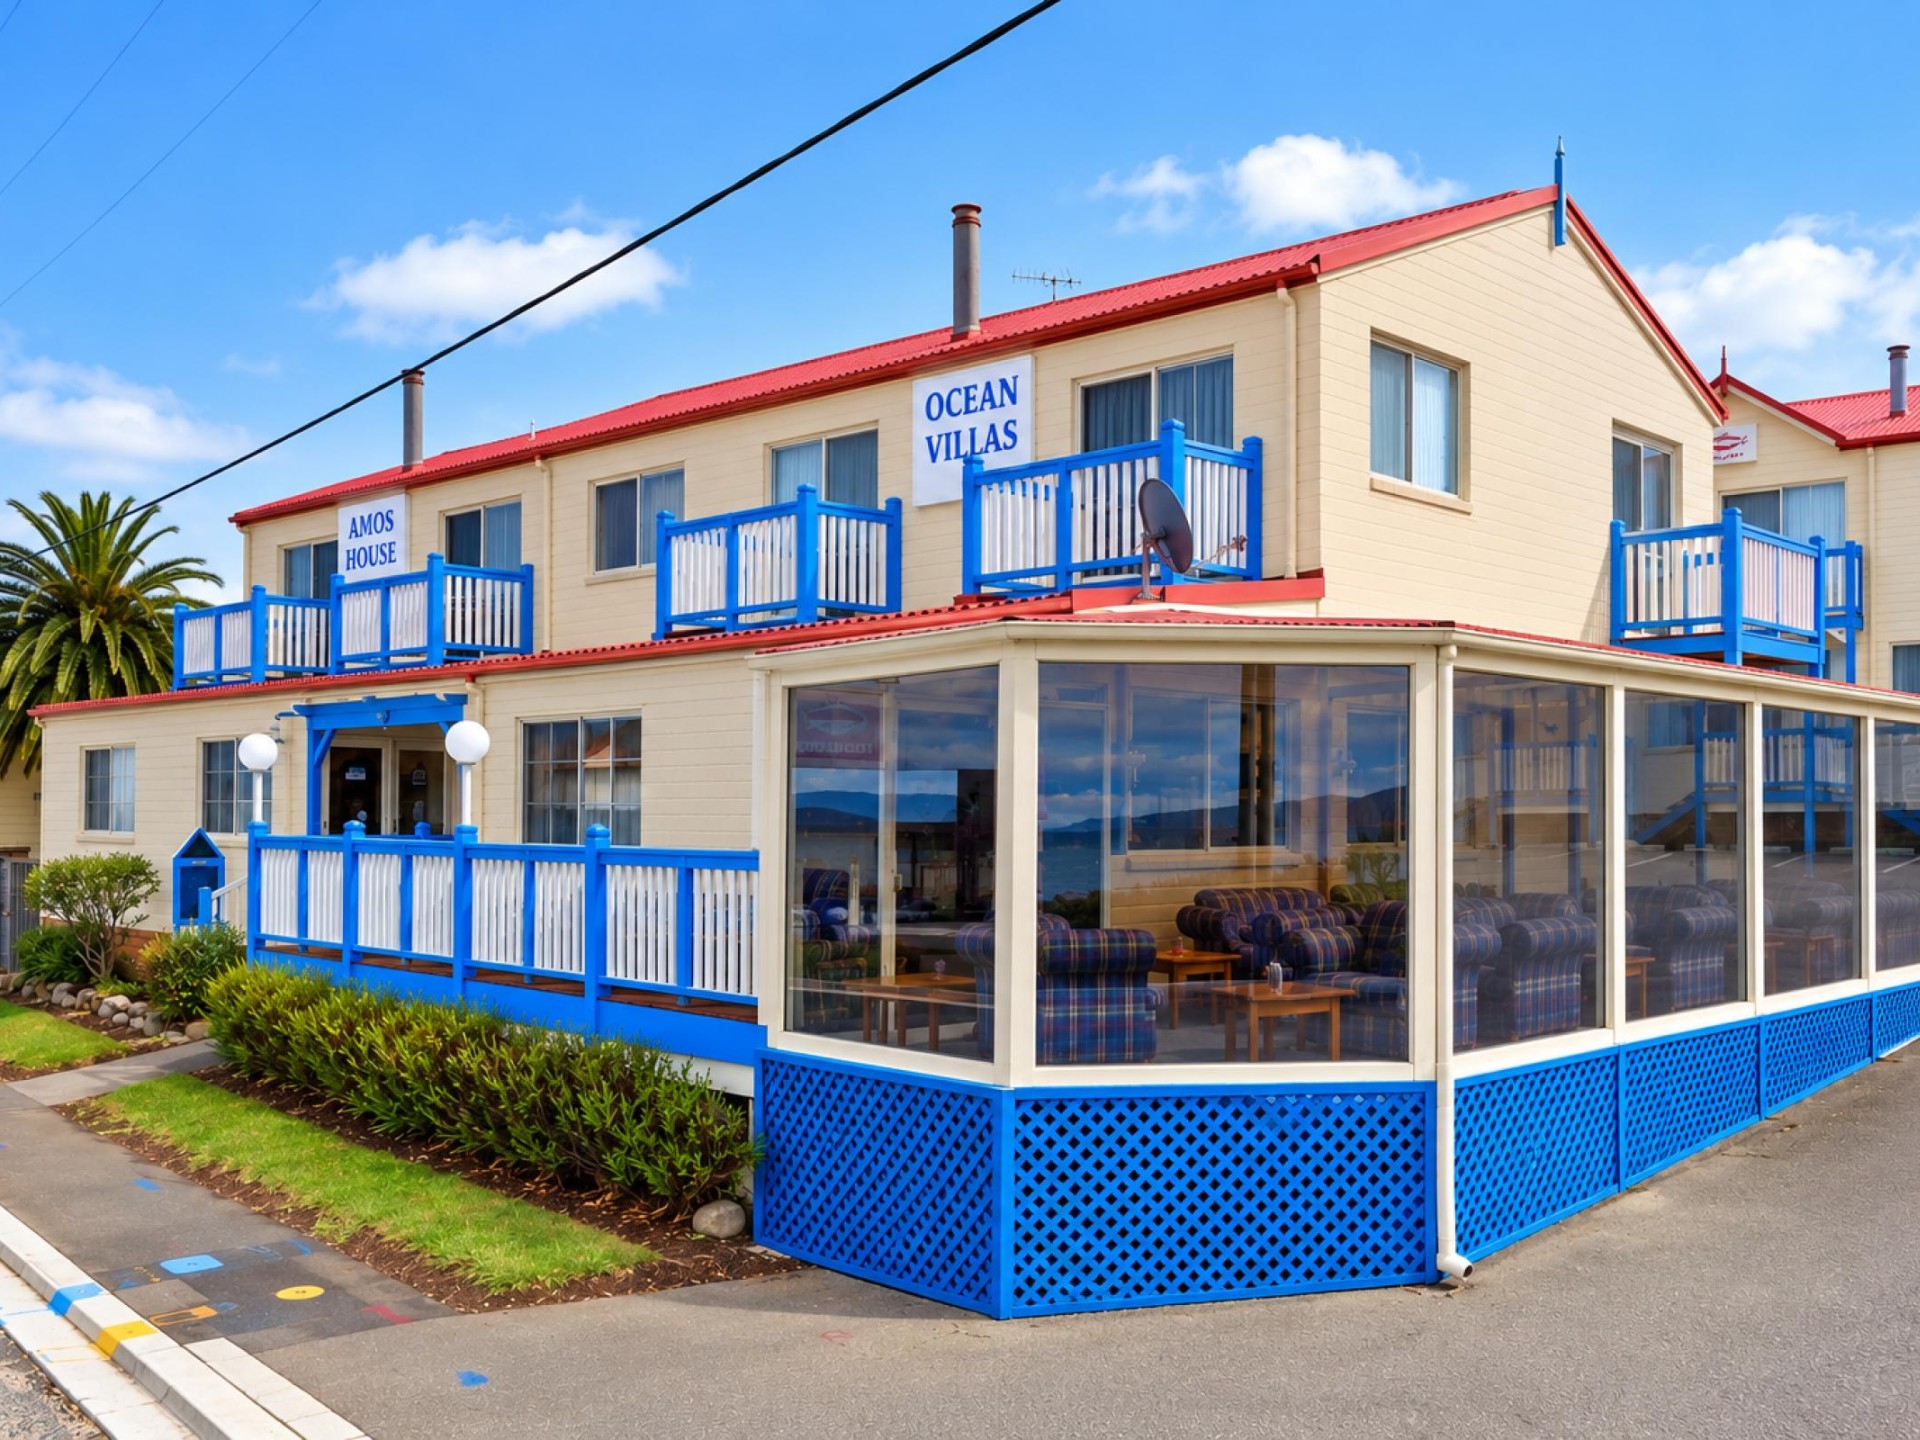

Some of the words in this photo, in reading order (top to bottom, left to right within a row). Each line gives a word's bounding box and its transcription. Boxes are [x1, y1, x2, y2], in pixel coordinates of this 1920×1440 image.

[925, 375, 1019, 422] OCEAN
[925, 419, 1018, 464] VILLAS
[348, 509, 395, 540] AMOS
[345, 541, 397, 571] HOUSE
